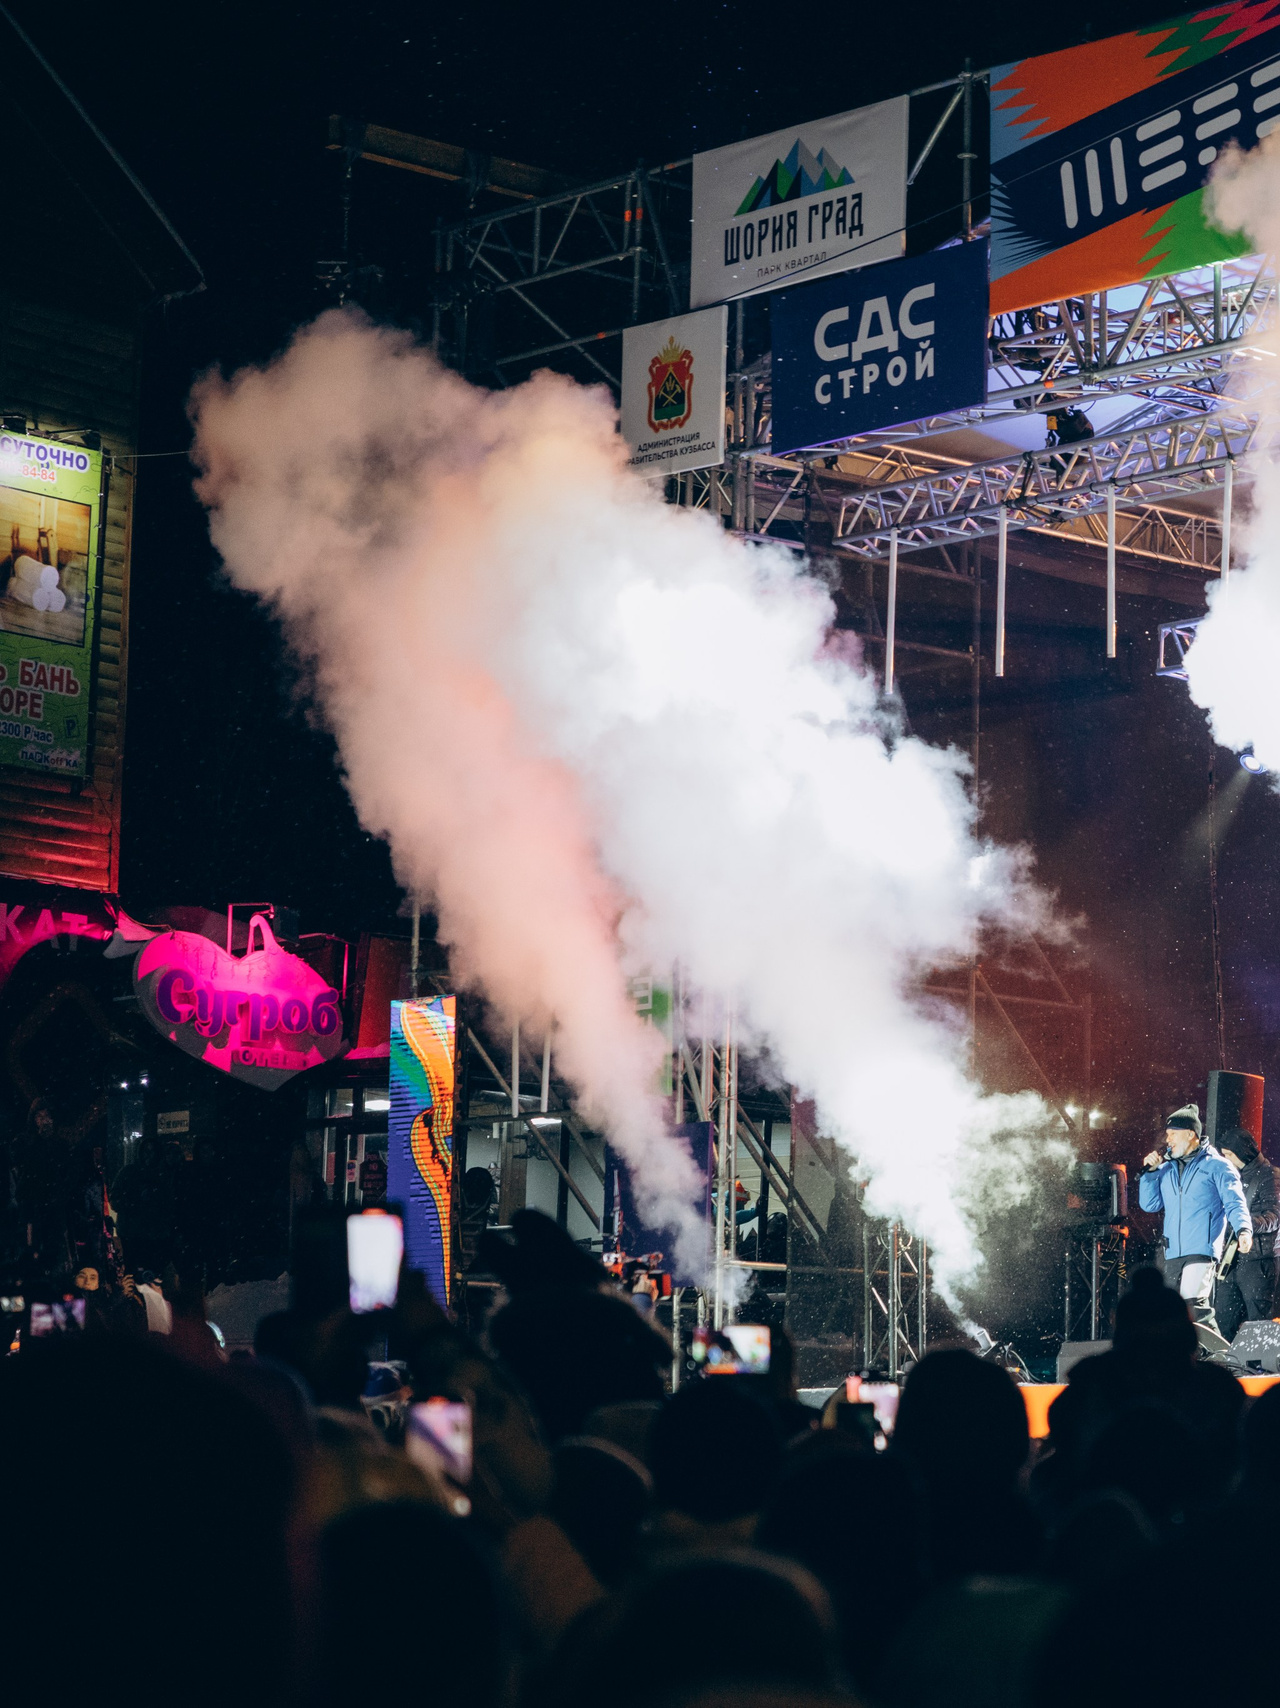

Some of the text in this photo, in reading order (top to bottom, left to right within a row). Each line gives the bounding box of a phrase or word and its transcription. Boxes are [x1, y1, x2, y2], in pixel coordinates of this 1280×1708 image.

[724, 192, 864, 267] ШОРИЯ ГРАД
[757, 251, 827, 278] ПАРК КВАРТАЛ
[813, 283, 935, 362] СДС
[814, 341, 935, 405] СТРОЙ
[626, 440, 716, 466] РАВИТЕЛЬСТВА КУЗБАССА
[637, 431, 700, 453] АДМИНИСТРАЦИЯ
[20, 660, 80, 695] БАНЬ
[0, 721, 21, 737] 300
[157, 967, 340, 1042] Сугроб
